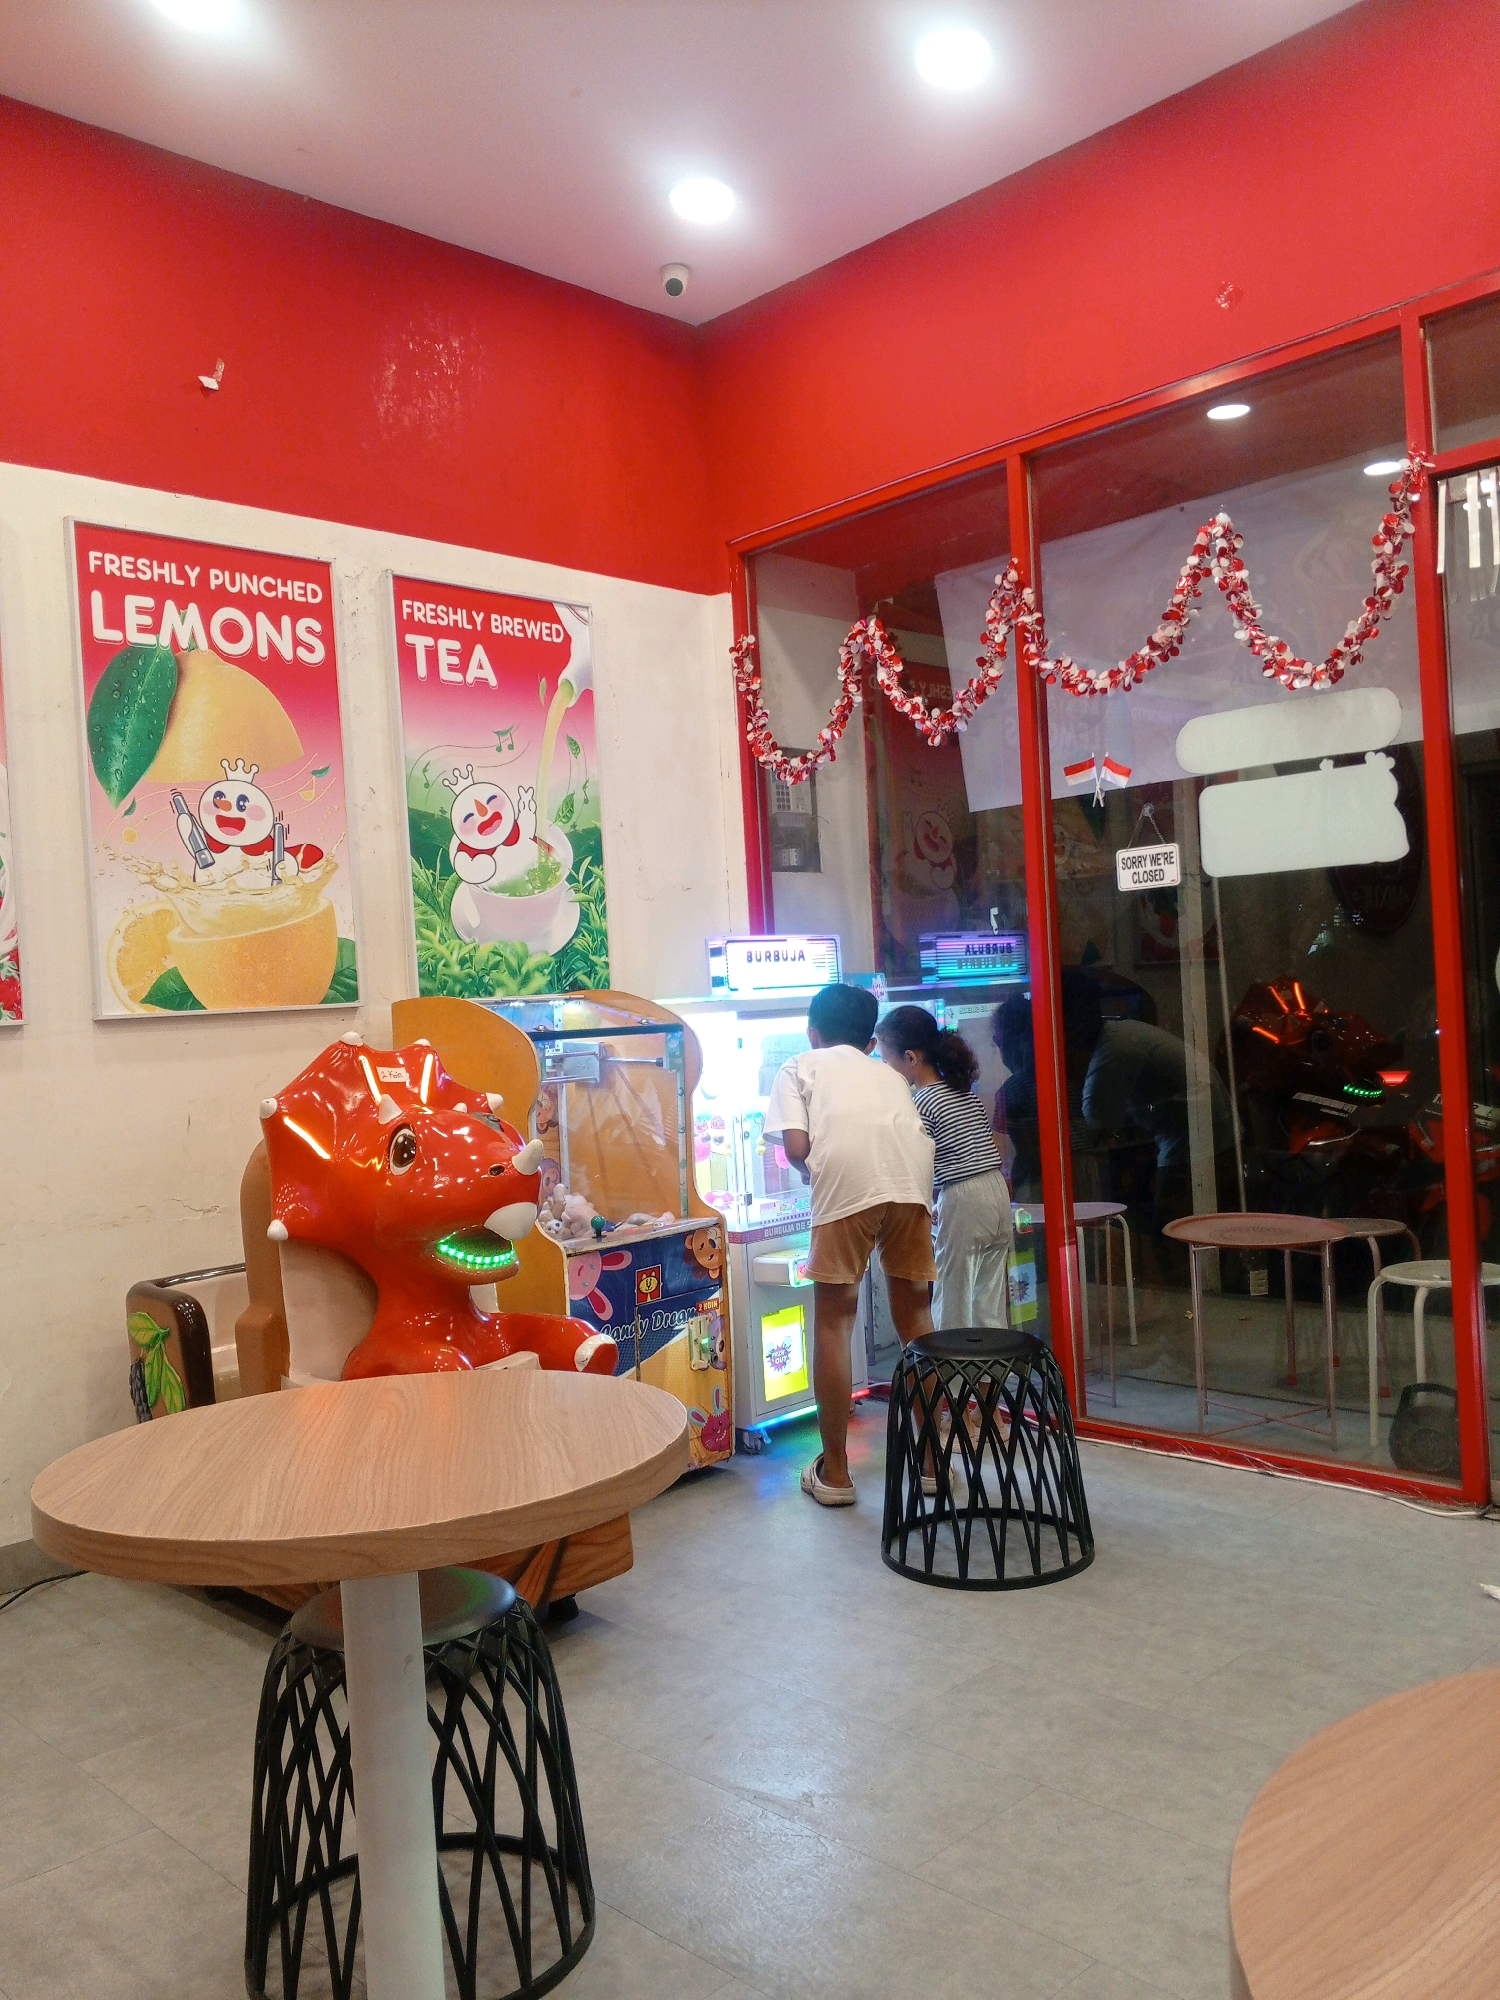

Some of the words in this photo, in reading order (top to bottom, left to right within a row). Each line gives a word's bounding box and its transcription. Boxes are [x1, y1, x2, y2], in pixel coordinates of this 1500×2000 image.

[88, 551, 200, 587] FRESHLY
[209, 568, 323, 604] PUNCHED
[91, 590, 326, 667] LEMONS
[402, 599, 485, 631] FRESHLY
[490, 613, 565, 643] BREWED
[404, 633, 498, 690] TEA
[1121, 854, 1148, 870] SORRY
[1149, 851, 1175, 867] WE'RE
[1132, 869, 1165, 884] CLOSED
[746, 949, 806, 963] BURBUJA
[764, 1223, 795, 1237] BURBUJA
[796, 1222, 806, 1231] DE
[699, 1303, 703, 1311] 2
[704, 1300, 718, 1310] KOIN
